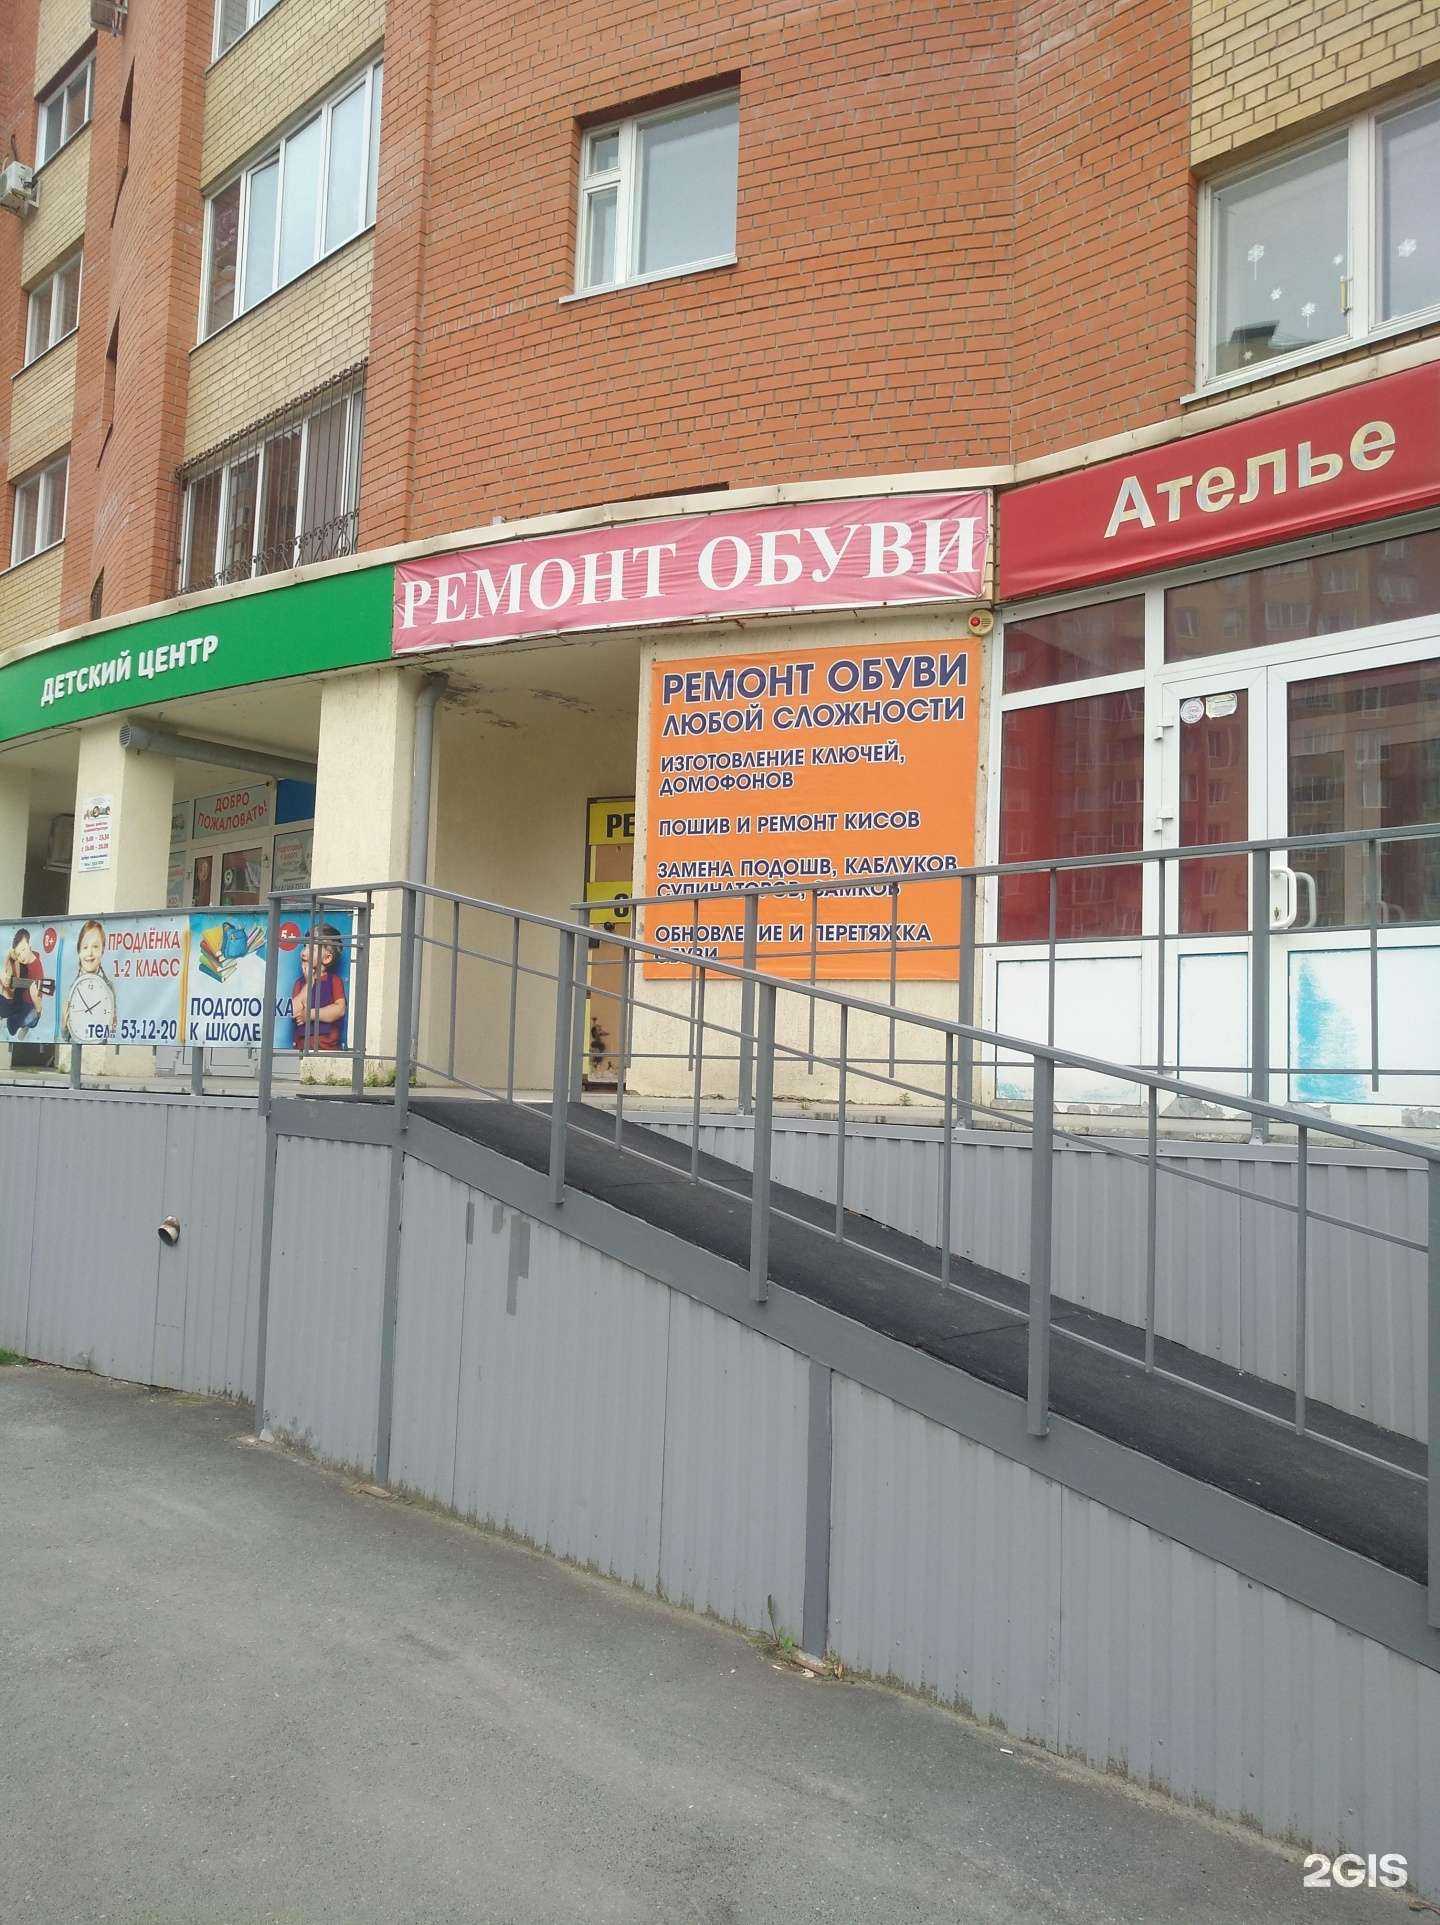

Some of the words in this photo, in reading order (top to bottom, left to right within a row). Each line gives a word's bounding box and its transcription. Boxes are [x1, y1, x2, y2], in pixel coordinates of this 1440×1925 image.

[1103, 420, 1397, 538] Ателье
[398, 542, 677, 630] РЕМОНТ
[698, 516, 983, 592] ОБУВИ
[40, 650, 132, 707] ДЕТСКИЙ
[138, 635, 218, 679] ЦЕНТР
[663, 663, 815, 704] РЕМОНТ
[827, 652, 967, 693] ОБУВИ
[662, 703, 764, 736] ЛЮБОЙ
[773, 697, 964, 729] СЛОЖНОСТИ
[660, 749, 804, 772] ИЗГОТОВЛЕНИЕ
[812, 741, 906, 765] КЛЮЧЕЙ,
[659, 771, 794, 796] ДОМОФОНОВ
[214, 792, 249, 813] ДОБРО
[198, 800, 268, 831] ПОЖАЛОВАТЬ!
[659, 818, 730, 836] ПОШИВ
[737, 817, 750, 833] И
[757, 813, 838, 832] РЕМОНТ
[844, 810, 920, 830] КИСОВ
[657, 861, 734, 878] ЗАМЕНА
[740, 858, 837, 879] ПОДОШВ,
[845, 855, 958, 874] КАБЛУКОВ
[109, 928, 181, 953] ПРОДЛЁНКА
[655, 925, 783, 942] ОБНОВЛЕИЕ
[789, 925, 804, 941] И
[113, 960, 132, 977] 1-2
[136, 959, 181, 977] КЛАСС
[190, 997, 294, 1019] ПОДГОТОКА
[189, 1022, 199, 1041] К
[205, 1022, 261, 1042] ШКОЛЕ
